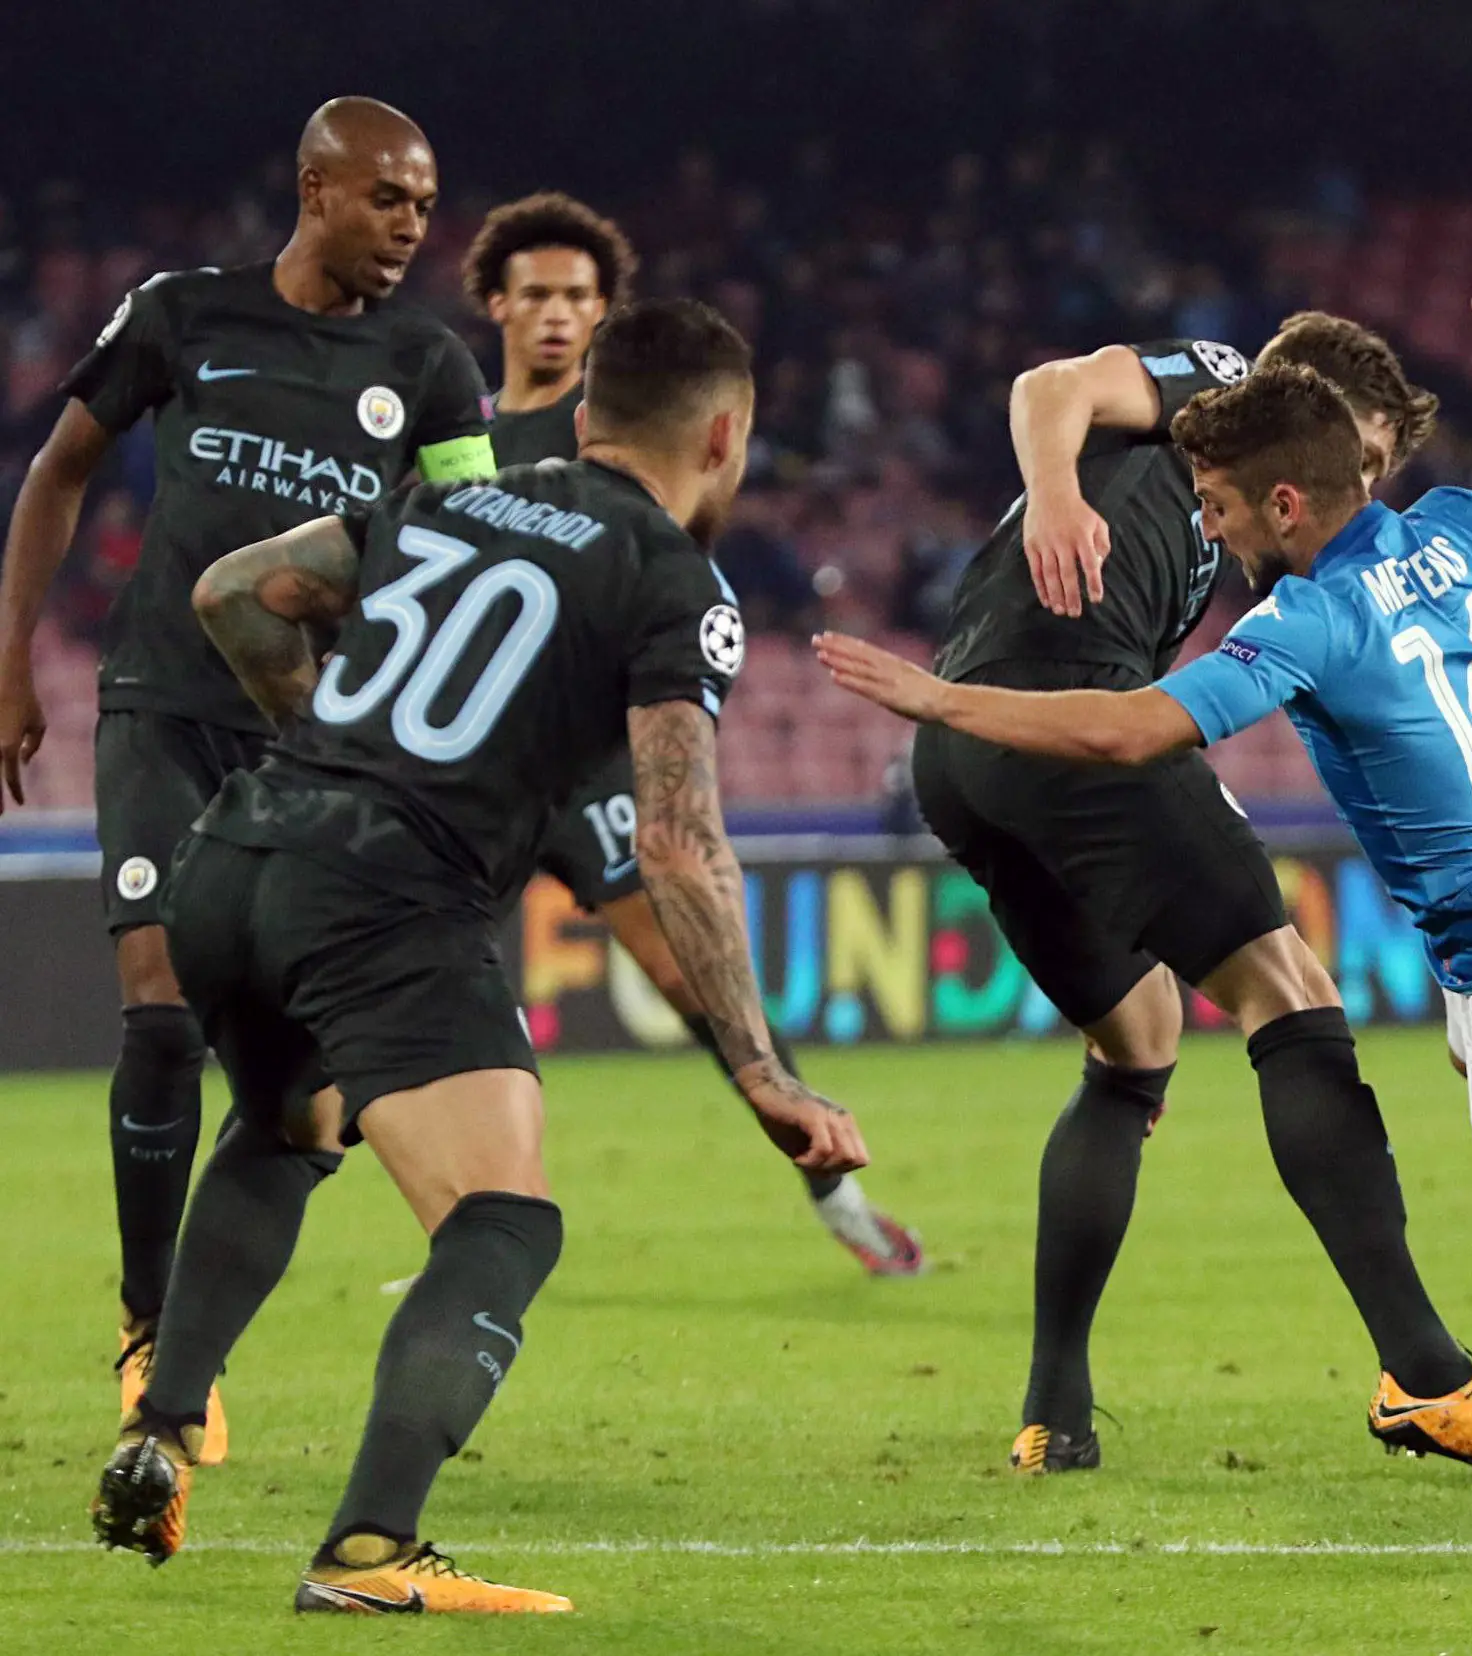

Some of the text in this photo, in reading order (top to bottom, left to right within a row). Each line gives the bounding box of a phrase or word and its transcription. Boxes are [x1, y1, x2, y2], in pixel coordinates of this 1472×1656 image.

[189, 426, 382, 502] ETIHAD
[216, 465, 348, 516] AIRWAYS
[443, 485, 605, 553] OTAMENDI
[313, 524, 559, 763] 30
[1219, 639, 1257, 662] SPECT
[582, 793, 637, 864] 19
[476, 1350, 503, 1382] CIT
